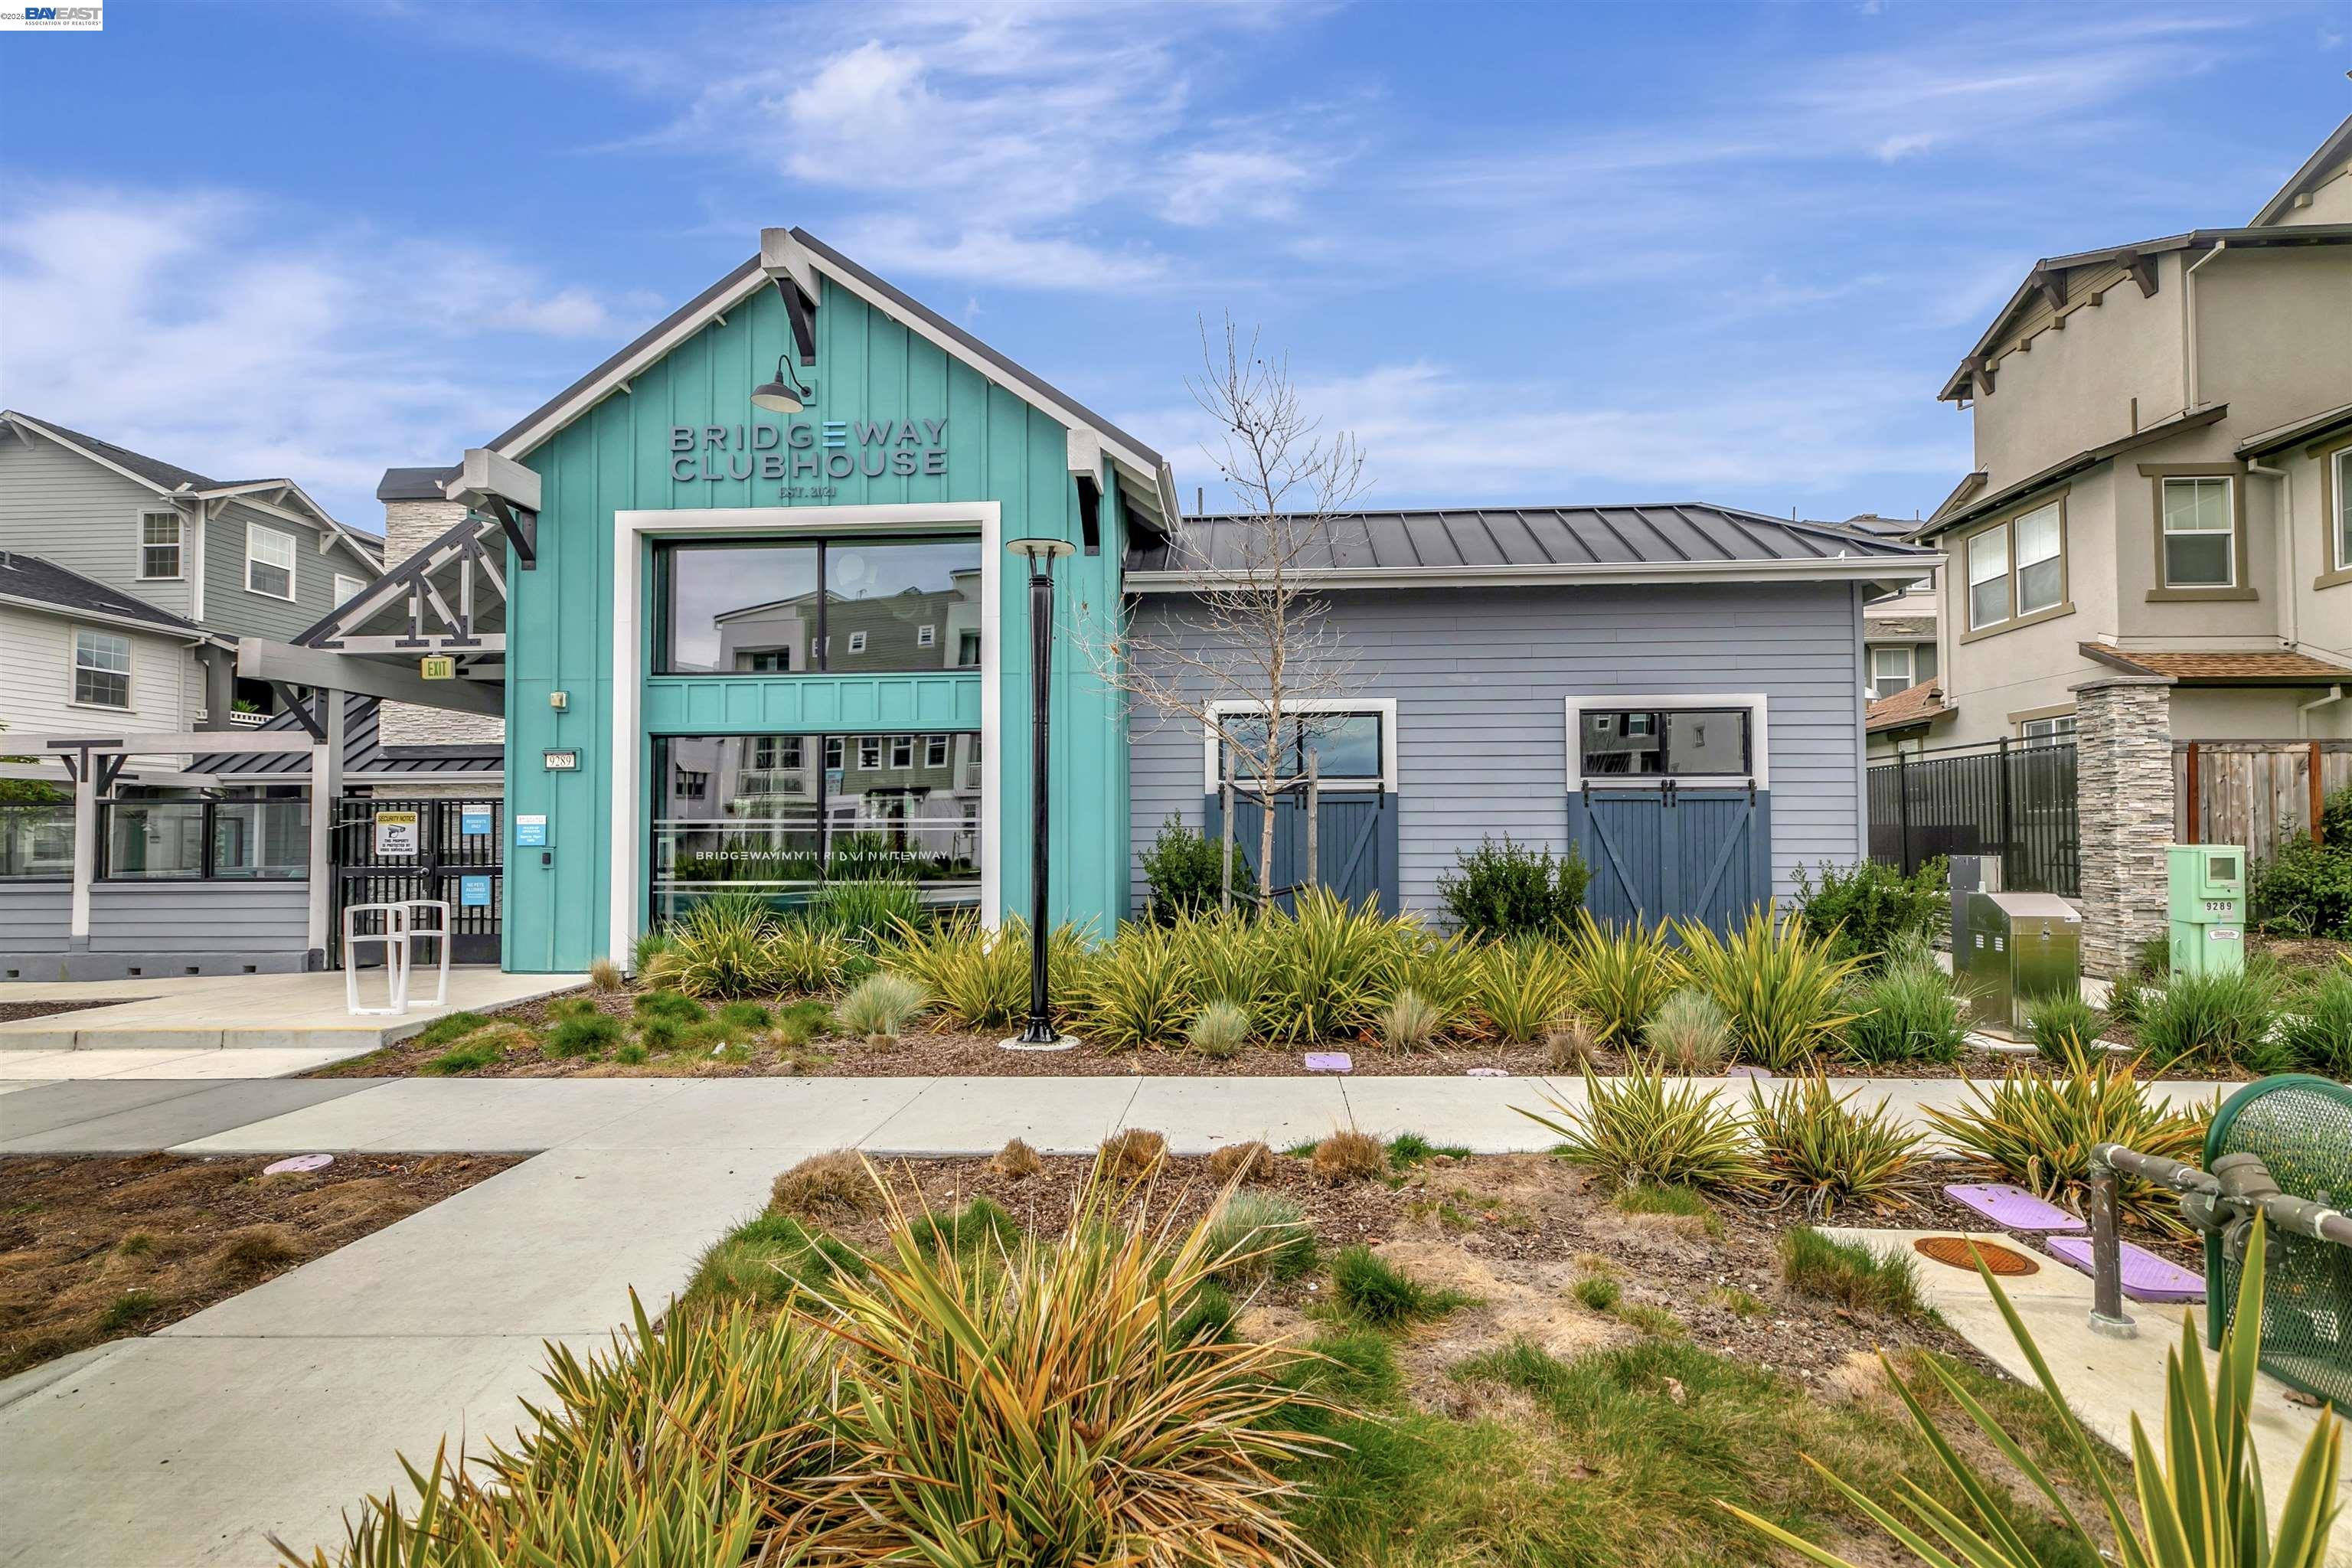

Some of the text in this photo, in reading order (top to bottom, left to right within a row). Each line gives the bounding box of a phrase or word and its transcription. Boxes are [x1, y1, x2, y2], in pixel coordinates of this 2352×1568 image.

[670, 417, 949, 452] BRIDGEWAY
[669, 447, 949, 482] CLUBHOUSE
[428, 661, 447, 677] EXIT
[549, 755, 571, 766] 9289
[2206, 902, 2233, 911] 9289
